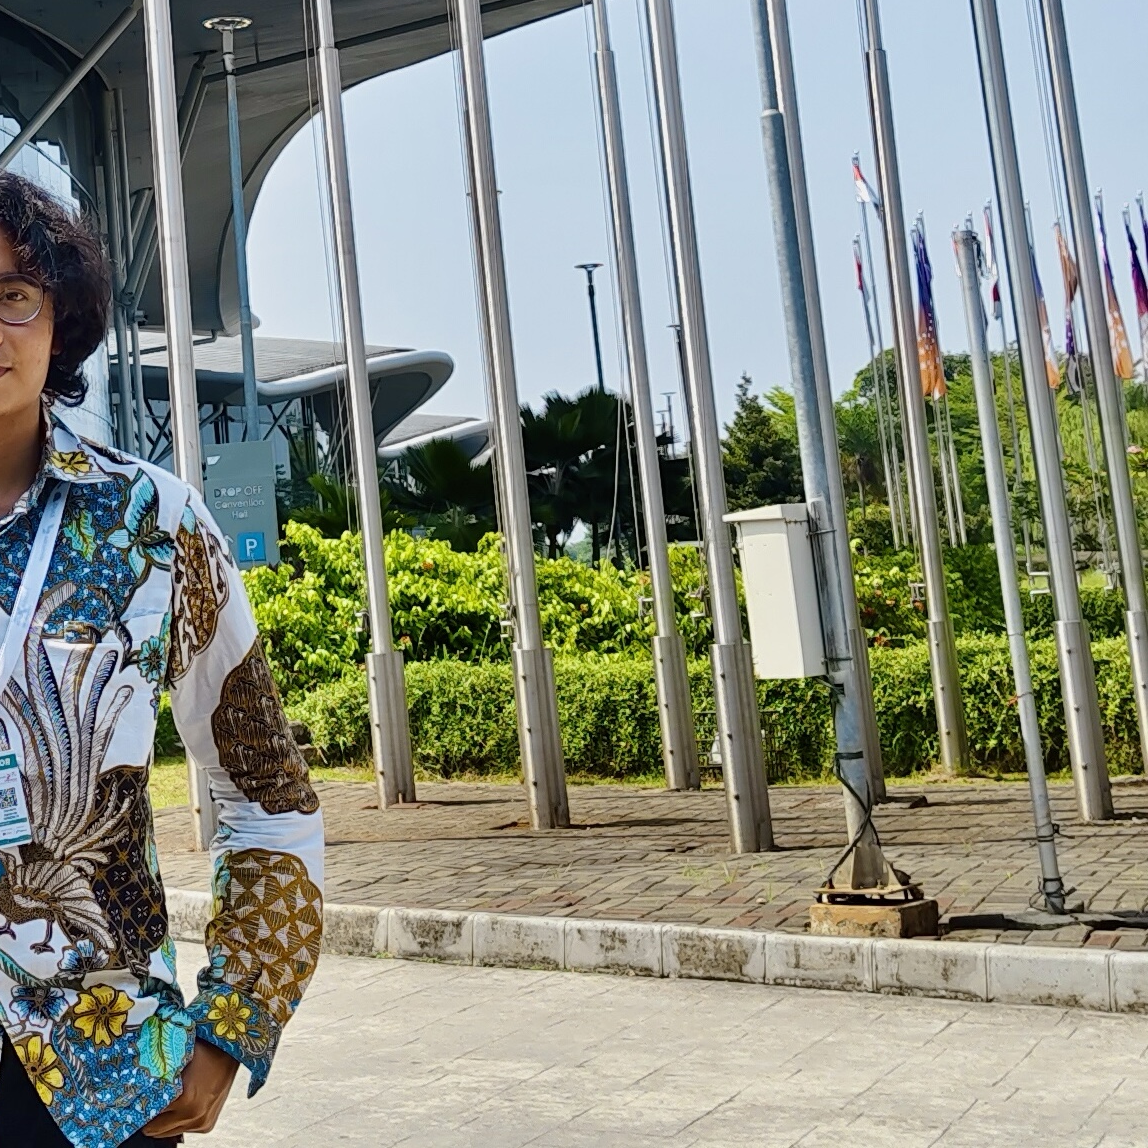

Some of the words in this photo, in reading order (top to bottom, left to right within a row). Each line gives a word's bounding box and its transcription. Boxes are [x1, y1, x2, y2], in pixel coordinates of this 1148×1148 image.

[213, 486, 242, 499] DROP
[244, 485, 263, 496] OFF
[245, 538, 258, 557] P
